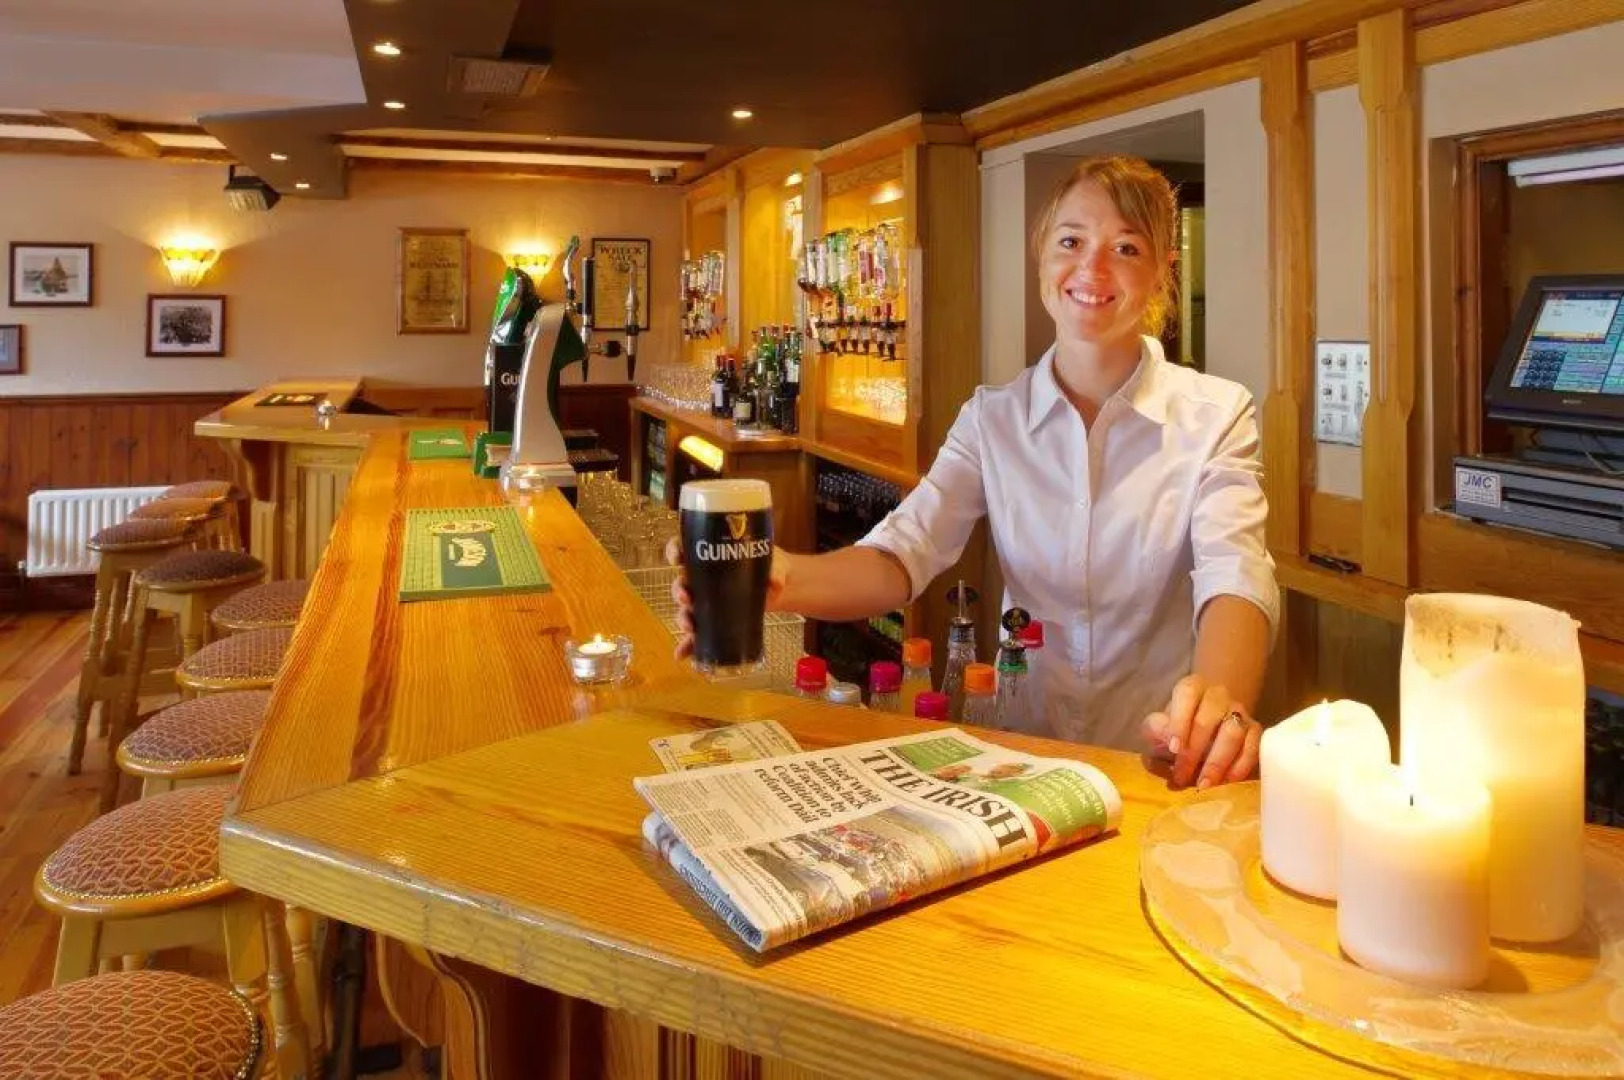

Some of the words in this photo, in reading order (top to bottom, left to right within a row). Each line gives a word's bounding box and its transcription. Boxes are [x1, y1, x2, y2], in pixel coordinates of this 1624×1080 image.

[1463, 473, 1492, 488] JMC
[696, 538, 770, 561] GUINNESS
[822, 757, 859, 781] Chief
[754, 768, 794, 803] reform
[772, 765, 821, 808] Coalition
[815, 808, 832, 818] to
[798, 773, 835, 801] action
[805, 760, 843, 791] admits
[840, 790, 870, 810] lack
[859, 749, 934, 793] THE
[920, 787, 1027, 849] IRISH
